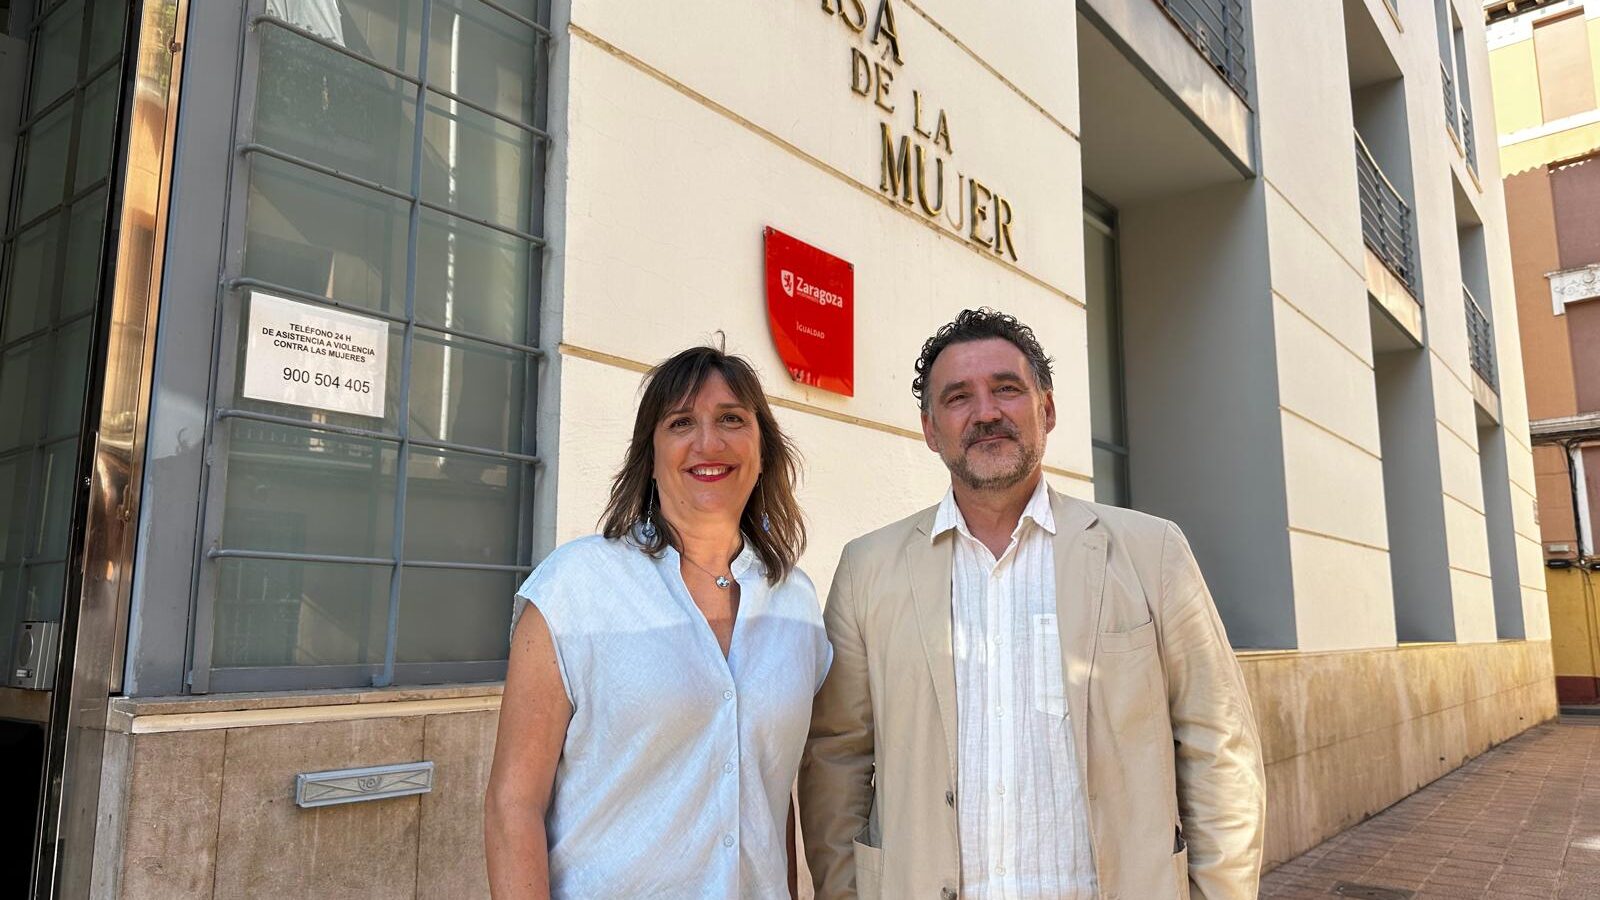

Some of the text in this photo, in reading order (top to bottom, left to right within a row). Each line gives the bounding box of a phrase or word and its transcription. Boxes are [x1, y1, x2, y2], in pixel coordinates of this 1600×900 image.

[851, 47, 953, 155] DE LA
[880, 122, 1018, 262] MUJER
[796, 276, 843, 309] Zaragoza
[262, 327, 376, 356] DE ASISTENCIA A VIOLENCIA
[289, 323, 333, 339] TELÉFONO
[334, 332, 344, 341] 24
[273, 339, 366, 363] CONTRA LAS MUJERES
[283, 367, 370, 394] 900 504 405
